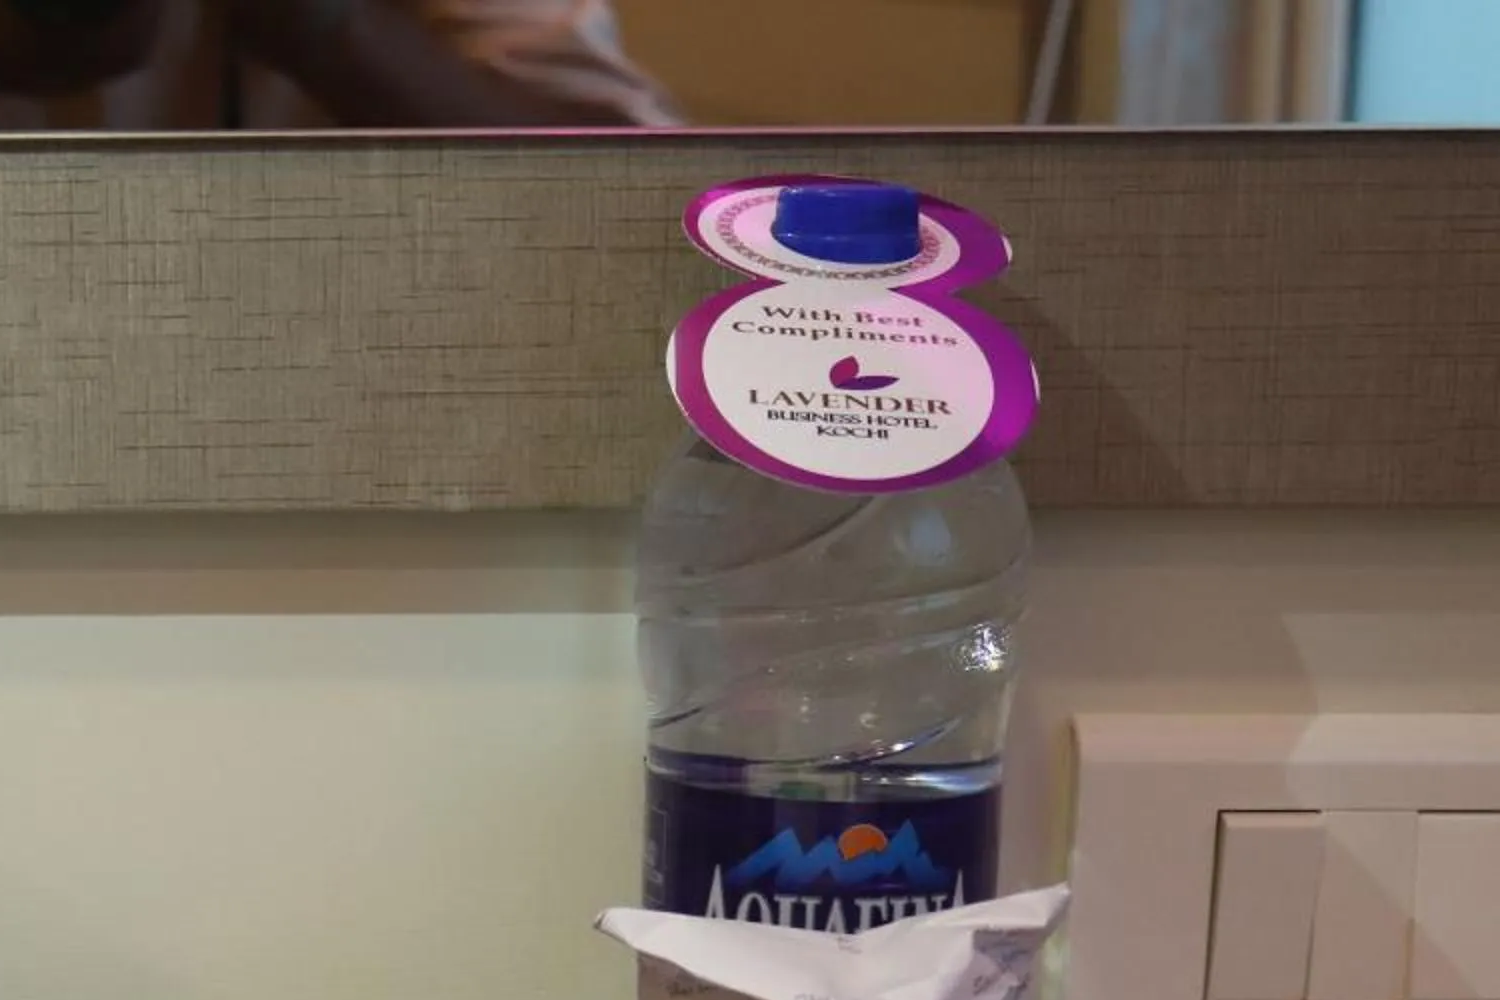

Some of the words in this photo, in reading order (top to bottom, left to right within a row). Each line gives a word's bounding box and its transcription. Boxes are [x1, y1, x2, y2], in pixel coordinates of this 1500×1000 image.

[762, 306, 842, 323] With
[854, 311, 925, 328] Best
[732, 320, 959, 346] Compliments
[749, 389, 953, 415] LAVENDER
[766, 409, 863, 426] BUSINESS
[866, 414, 939, 430] HOTEL
[816, 425, 890, 440] KOCHI
